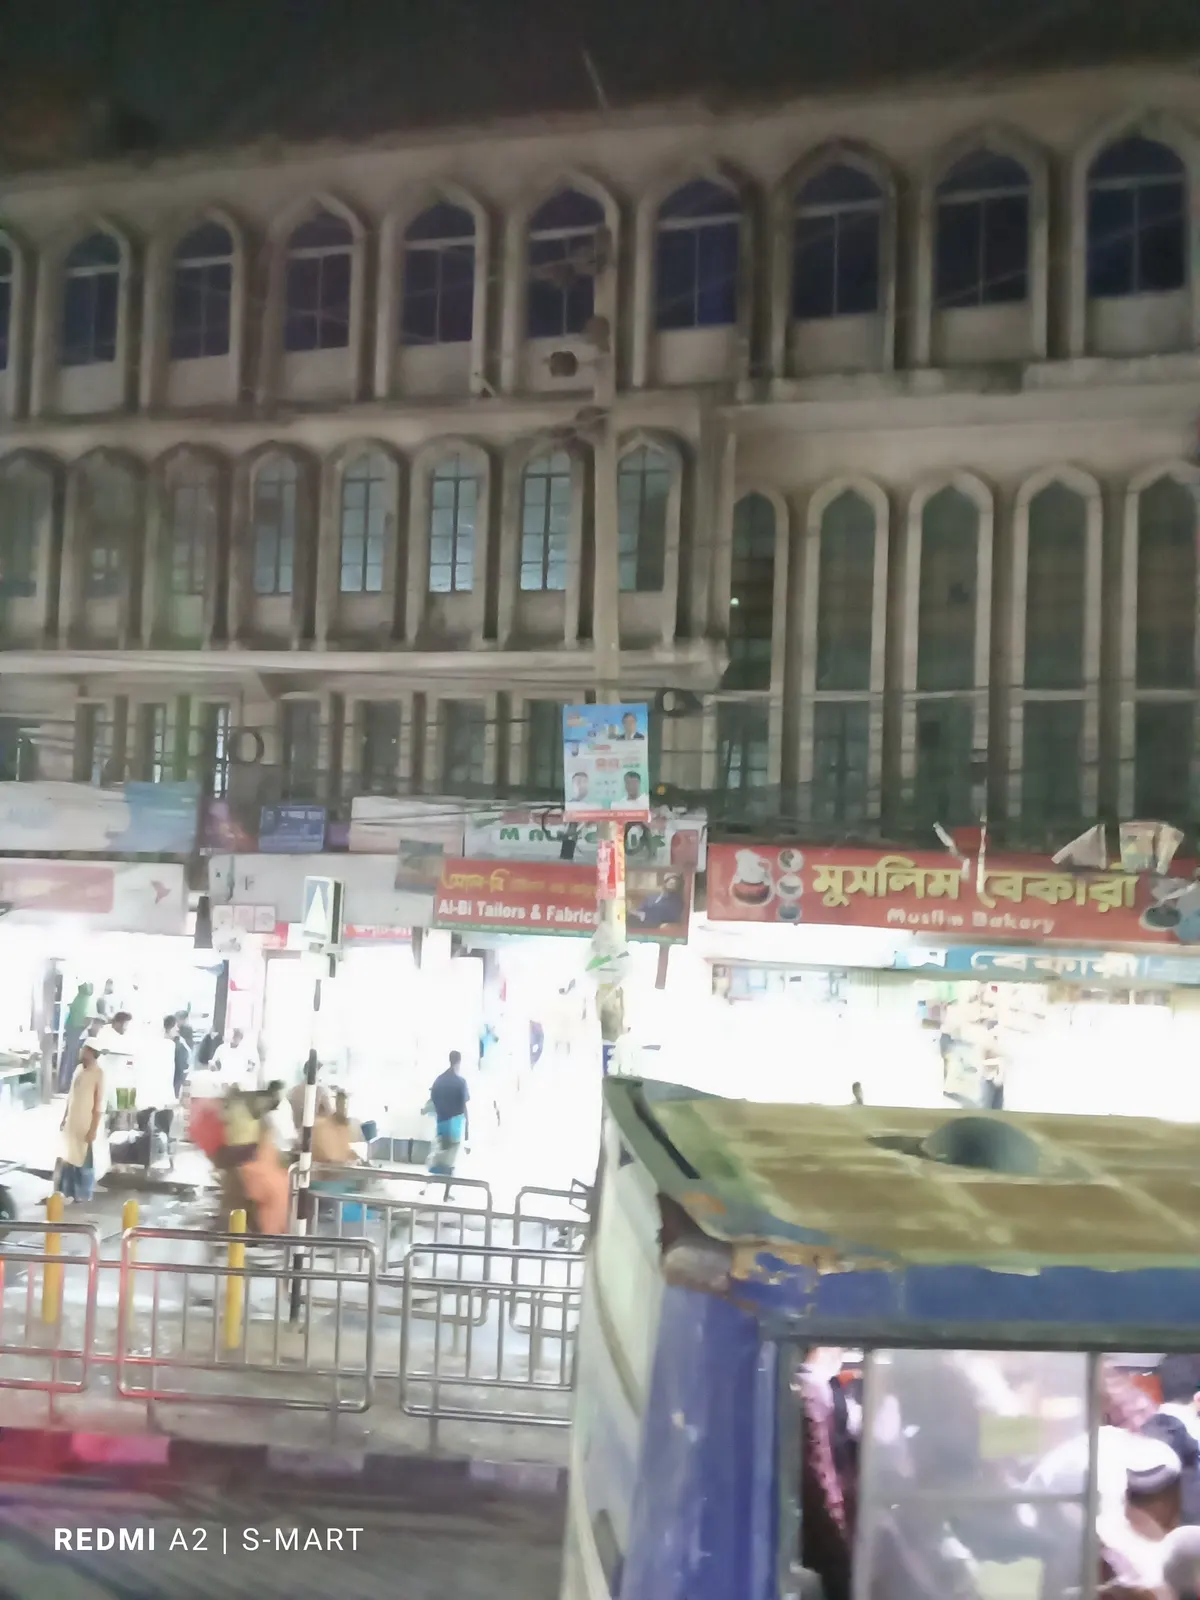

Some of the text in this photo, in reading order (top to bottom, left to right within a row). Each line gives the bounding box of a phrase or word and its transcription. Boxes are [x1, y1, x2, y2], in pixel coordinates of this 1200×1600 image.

[812, 855, 962, 907] মুসলিম
[477, 901, 526, 919] Tailors
[530, 903, 541, 920] &
[972, 911, 1055, 934] Bakery
